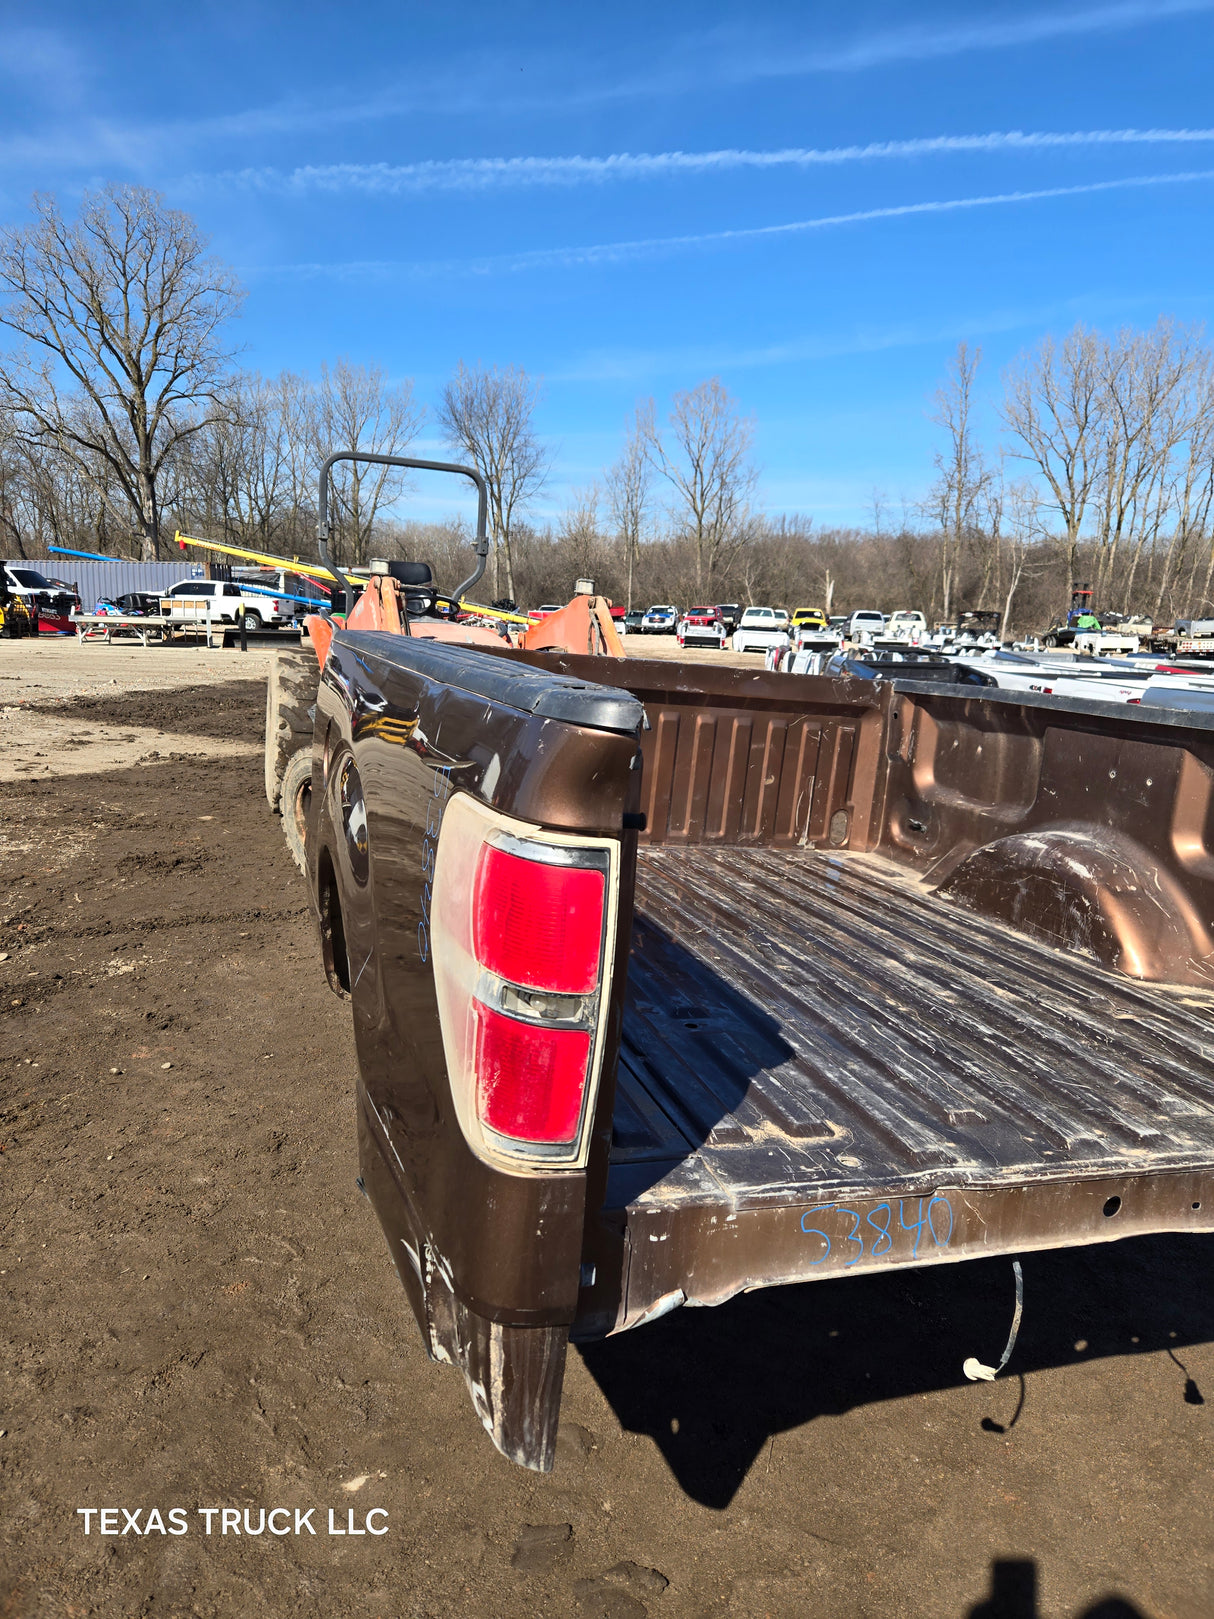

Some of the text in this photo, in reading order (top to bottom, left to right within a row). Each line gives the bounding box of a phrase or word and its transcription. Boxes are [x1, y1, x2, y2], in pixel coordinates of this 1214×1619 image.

[38, 612, 61, 620] BOSS
[417, 765, 452, 963] 53840
[800, 1197, 953, 1266] 53840
